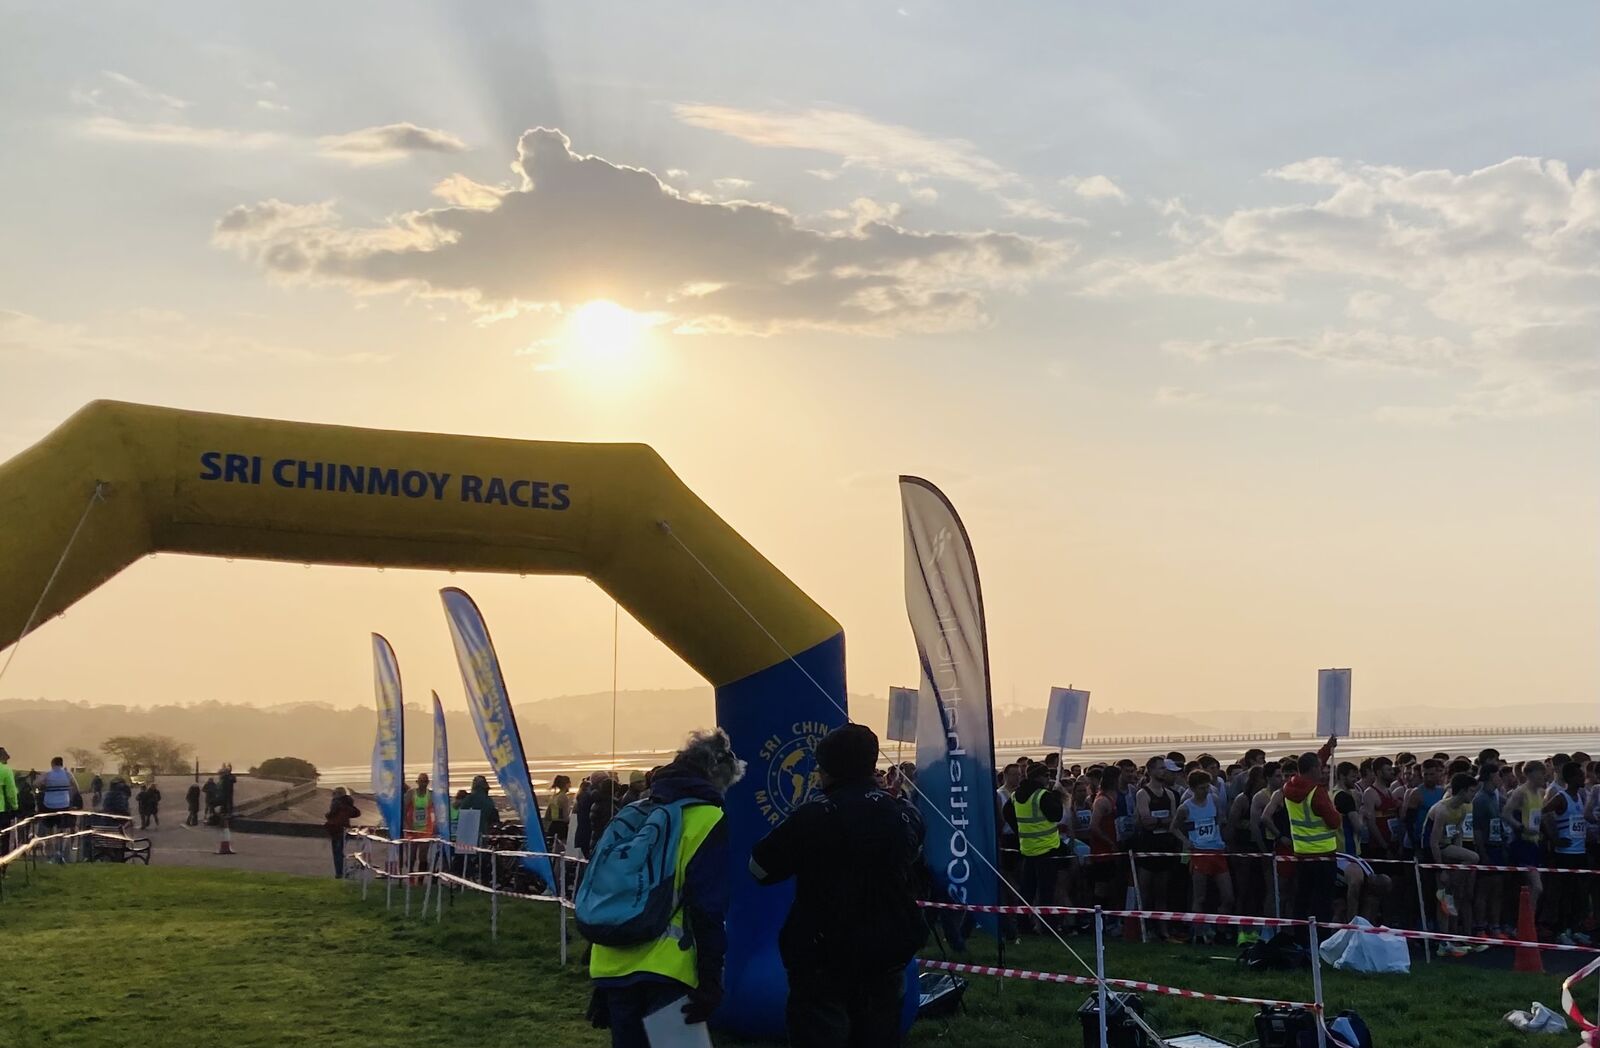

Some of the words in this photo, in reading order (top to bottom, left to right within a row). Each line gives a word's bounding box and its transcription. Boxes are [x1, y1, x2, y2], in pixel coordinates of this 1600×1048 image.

[200, 452, 261, 484] SRI
[272, 459, 450, 500] CHINMOY
[461, 475, 571, 511] RACES
[760, 734, 782, 760] SRI
[792, 721, 829, 736] CHIN
[755, 790, 780, 825] MAR
[1198, 825, 1214, 836] 647
